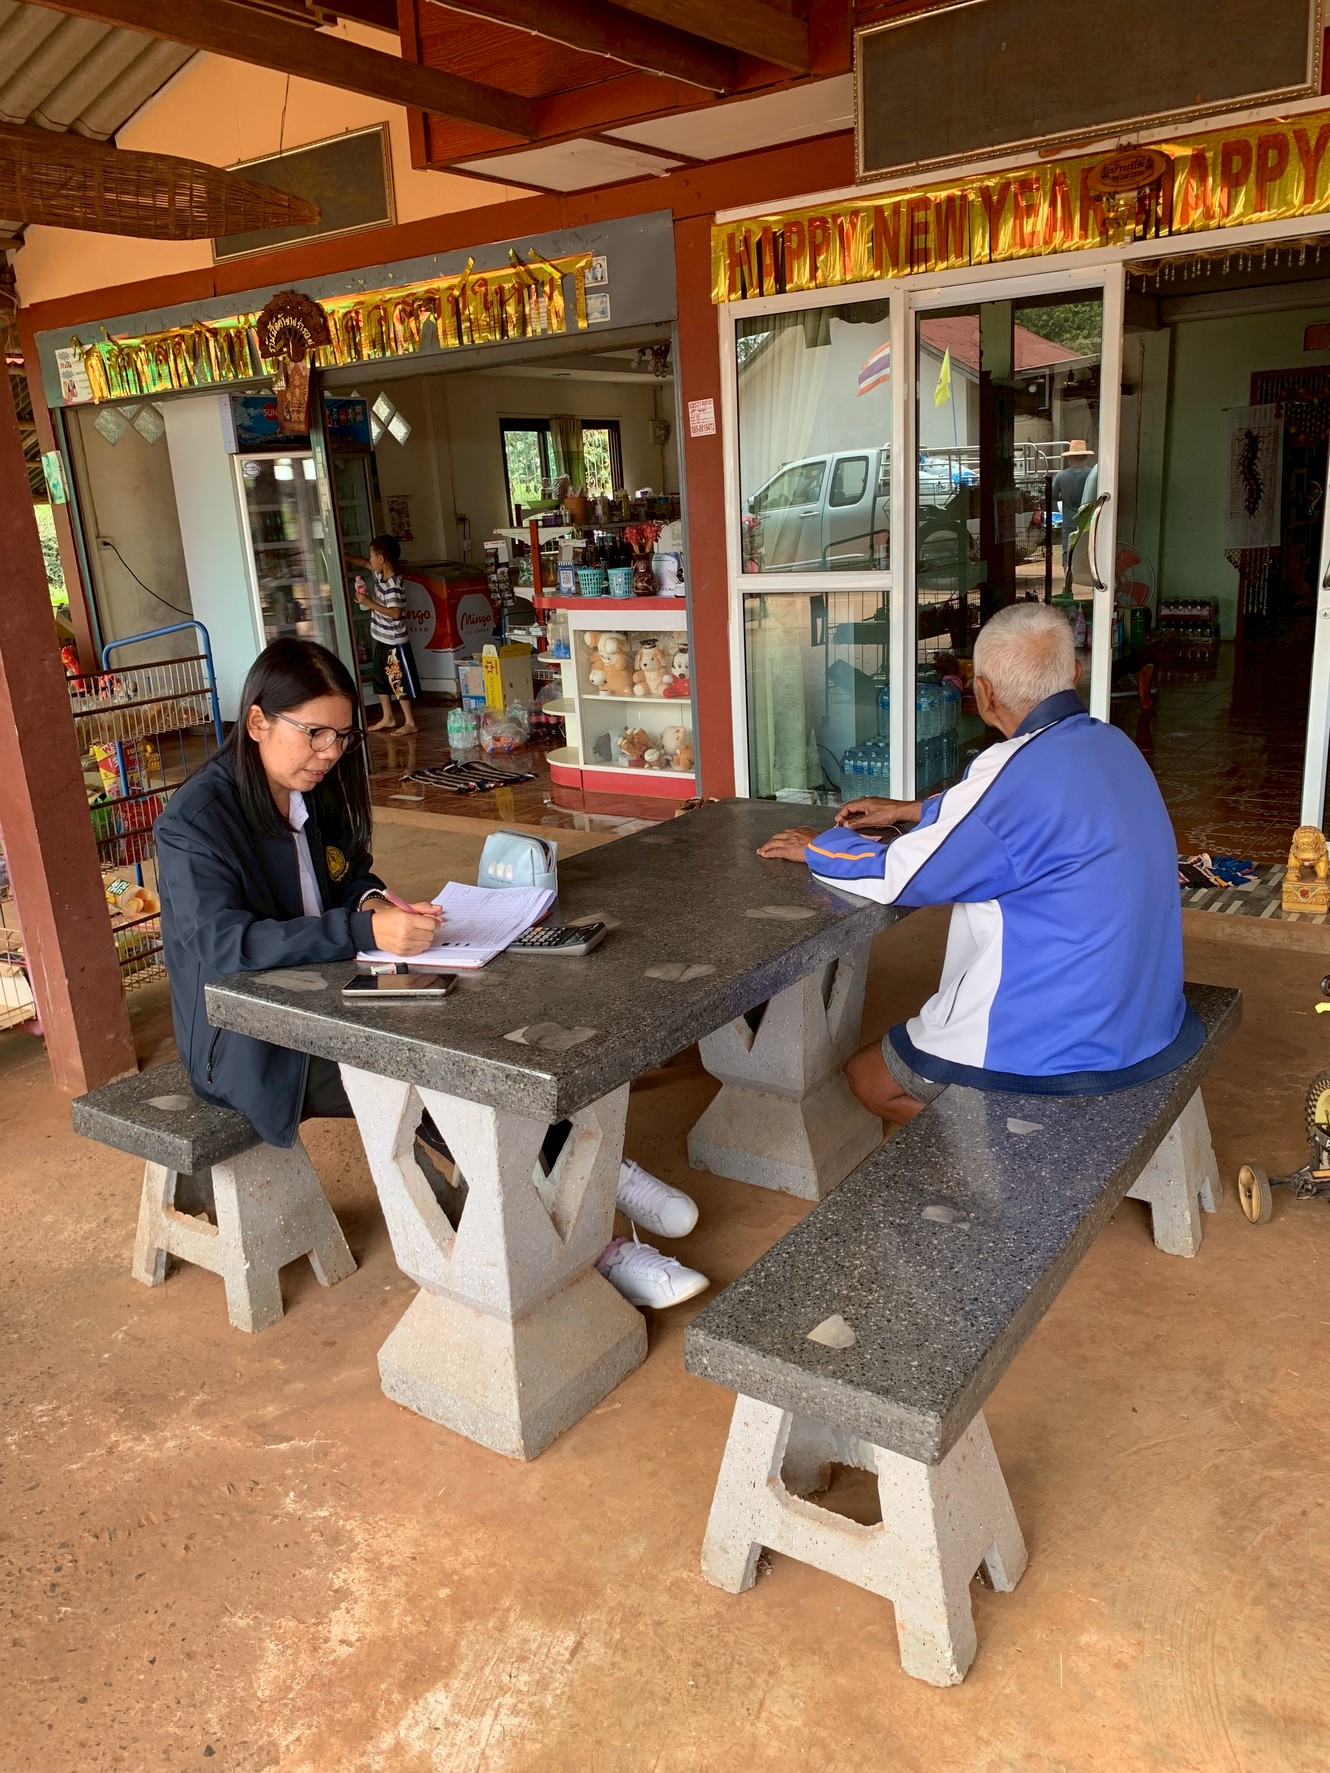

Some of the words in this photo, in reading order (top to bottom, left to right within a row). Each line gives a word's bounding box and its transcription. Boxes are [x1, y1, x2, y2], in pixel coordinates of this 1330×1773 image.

[727, 210, 860, 299] HAPPY
[874, 190, 969, 273] NEW
[979, 168, 1108, 260] YEAR
[461, 613, 491, 631] Mingo
